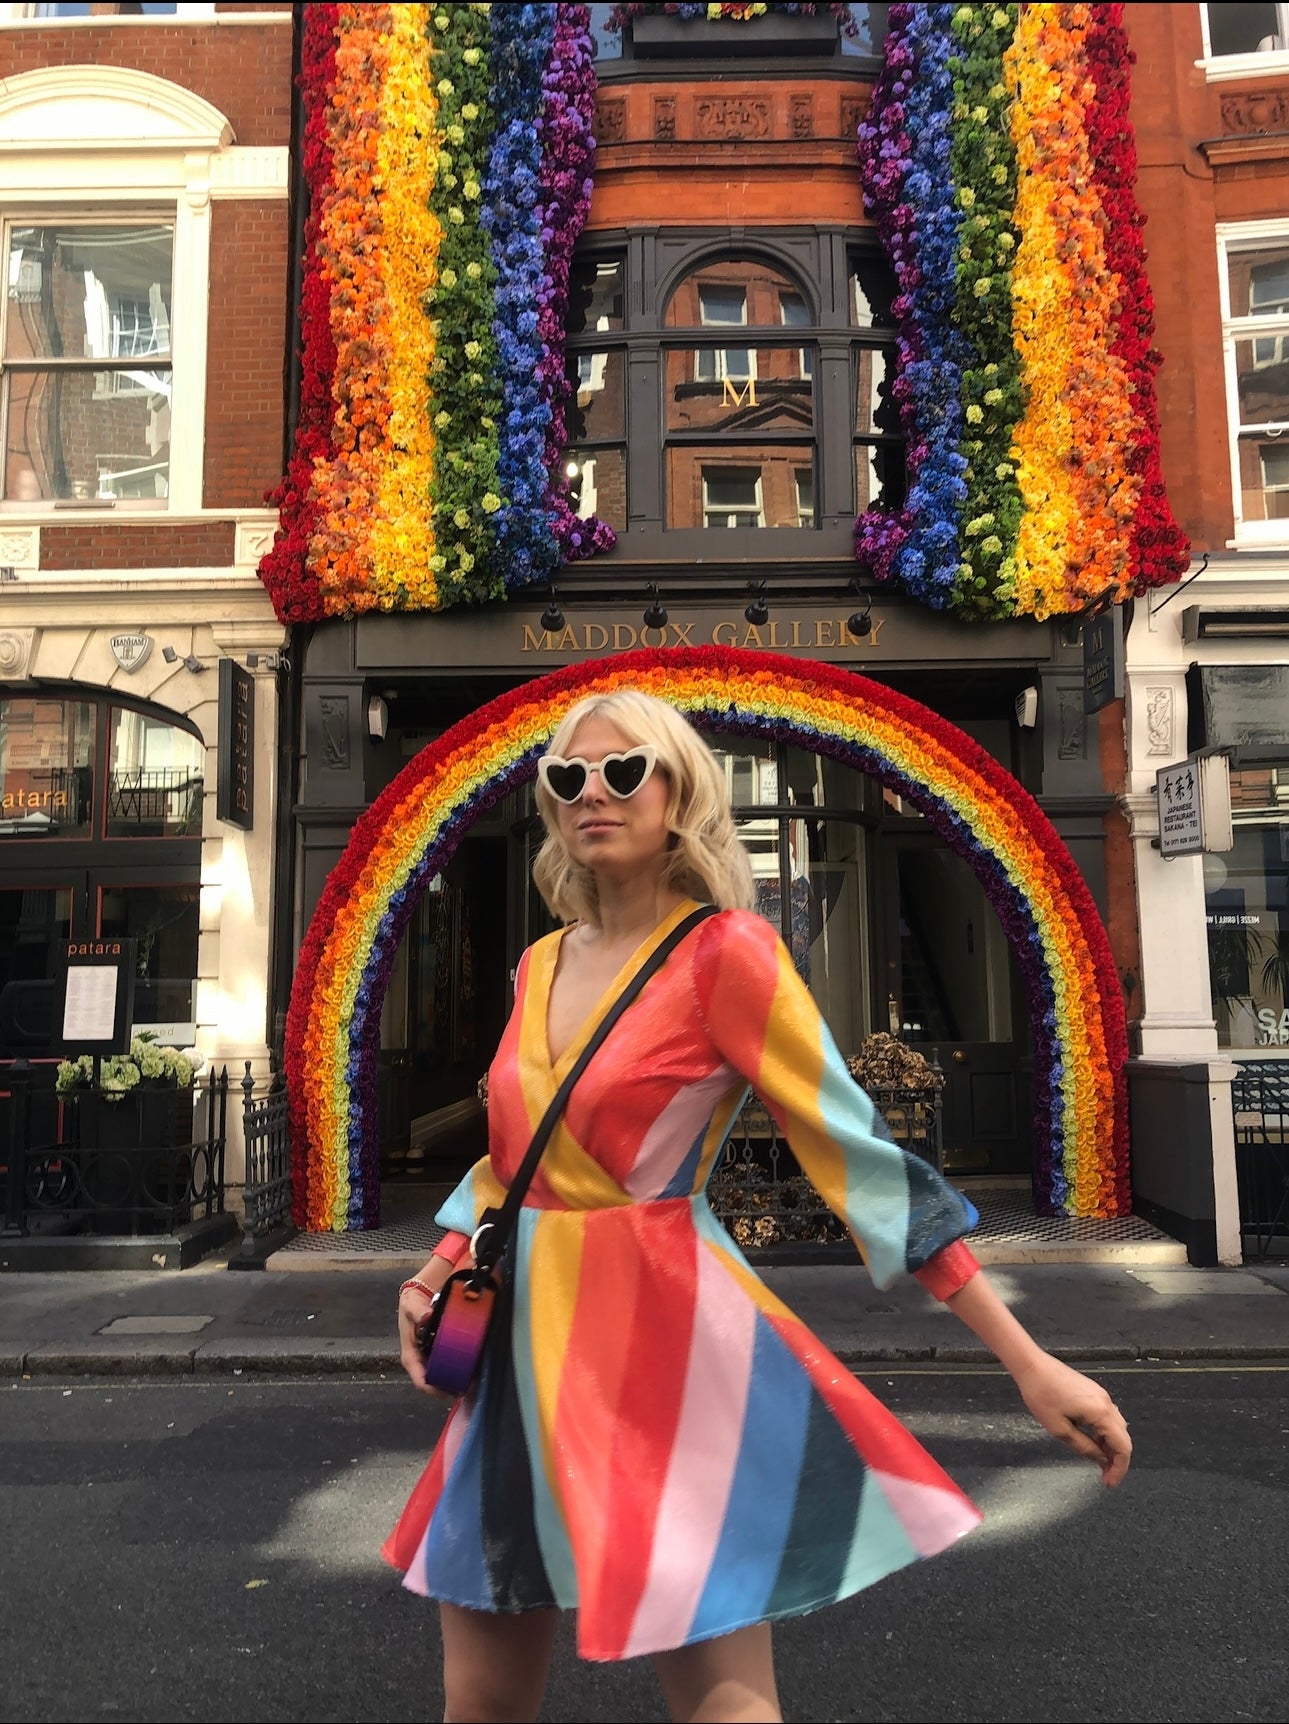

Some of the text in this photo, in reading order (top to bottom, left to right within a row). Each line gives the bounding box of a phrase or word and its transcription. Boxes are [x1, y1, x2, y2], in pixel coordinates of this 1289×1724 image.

[719, 377, 759, 407] M
[521, 620, 886, 652] MADDOX GALLERY
[236, 681, 249, 812] patara
[1167, 802, 1192, 814] JAPANESE
[1164, 811, 1196, 823] RESTAURANT
[1164, 823, 1185, 832] SAKANA
[68, 942, 121, 958] patara
